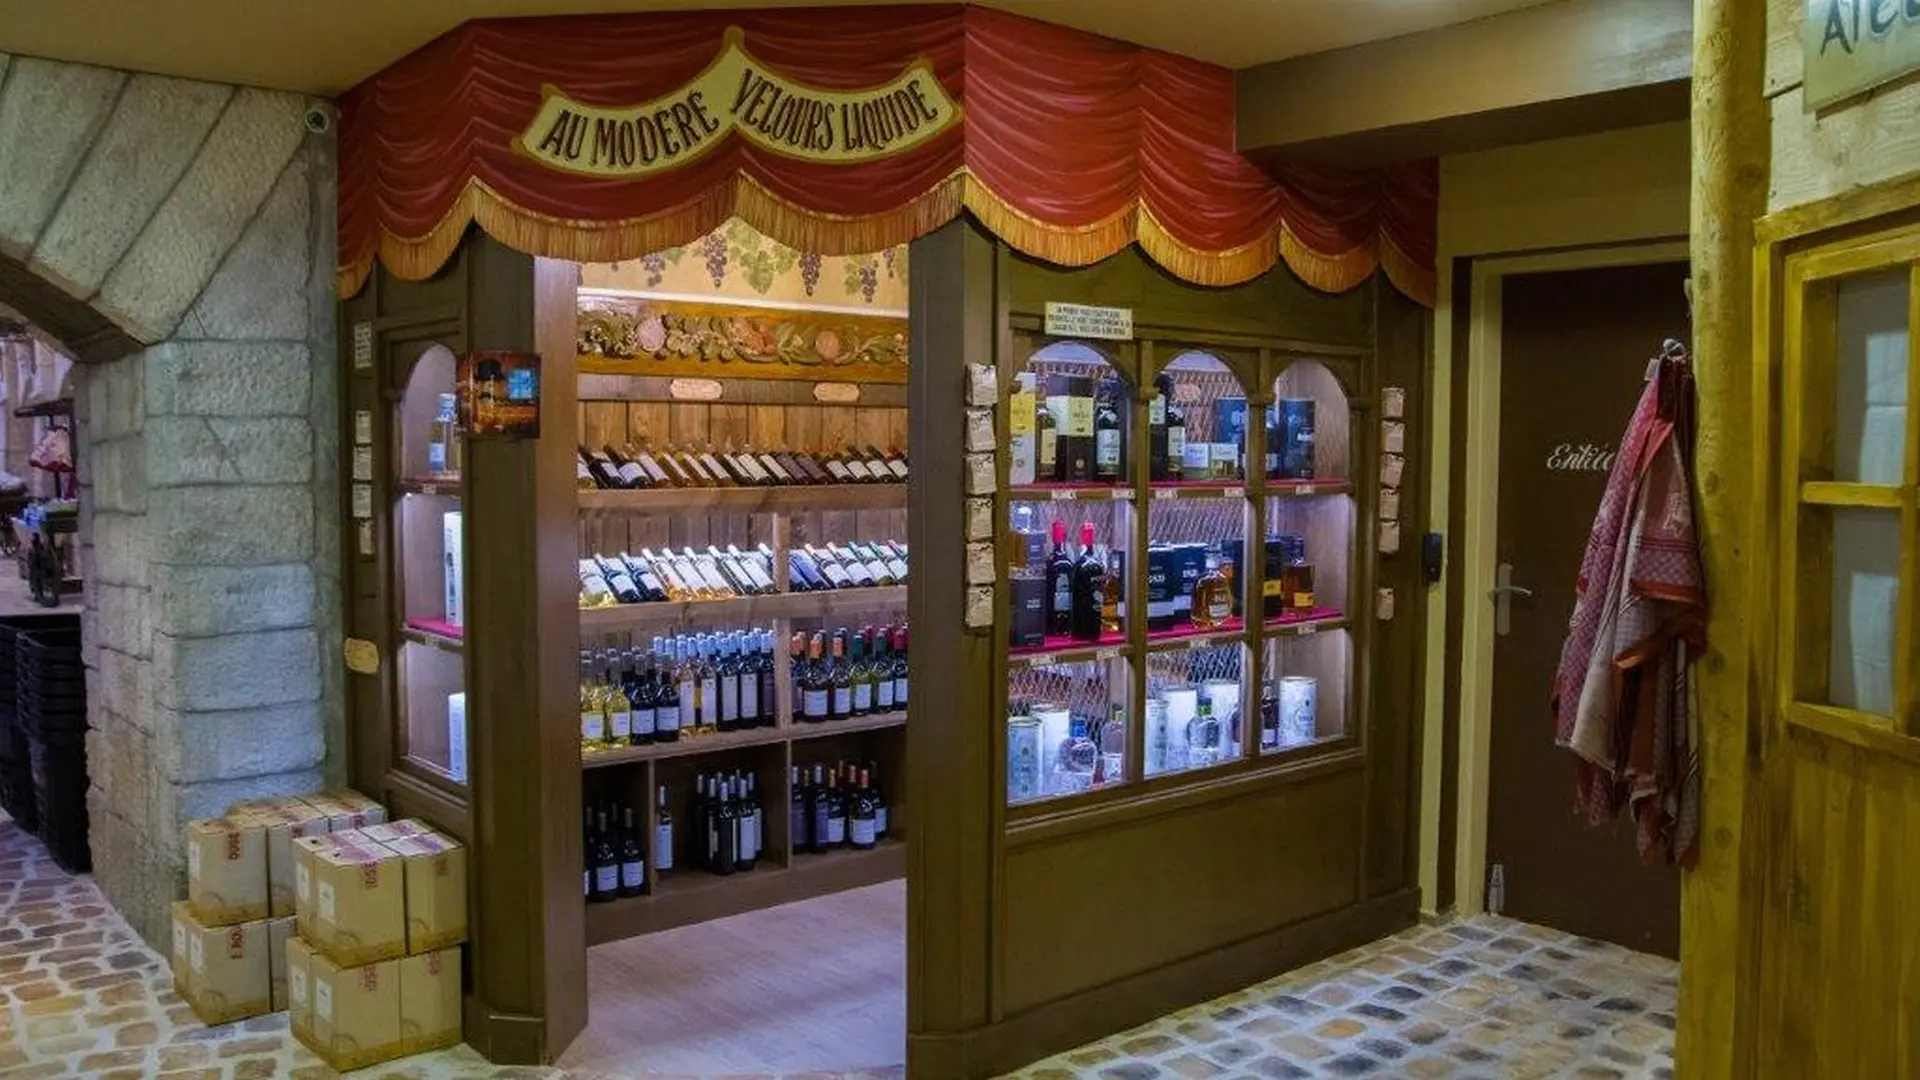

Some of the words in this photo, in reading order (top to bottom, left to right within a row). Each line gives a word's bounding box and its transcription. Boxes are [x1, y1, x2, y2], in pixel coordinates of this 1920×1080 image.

[539, 109, 588, 160] AU
[730, 68, 835, 150] VELOURS
[841, 79, 938, 150] LIQUIDE
